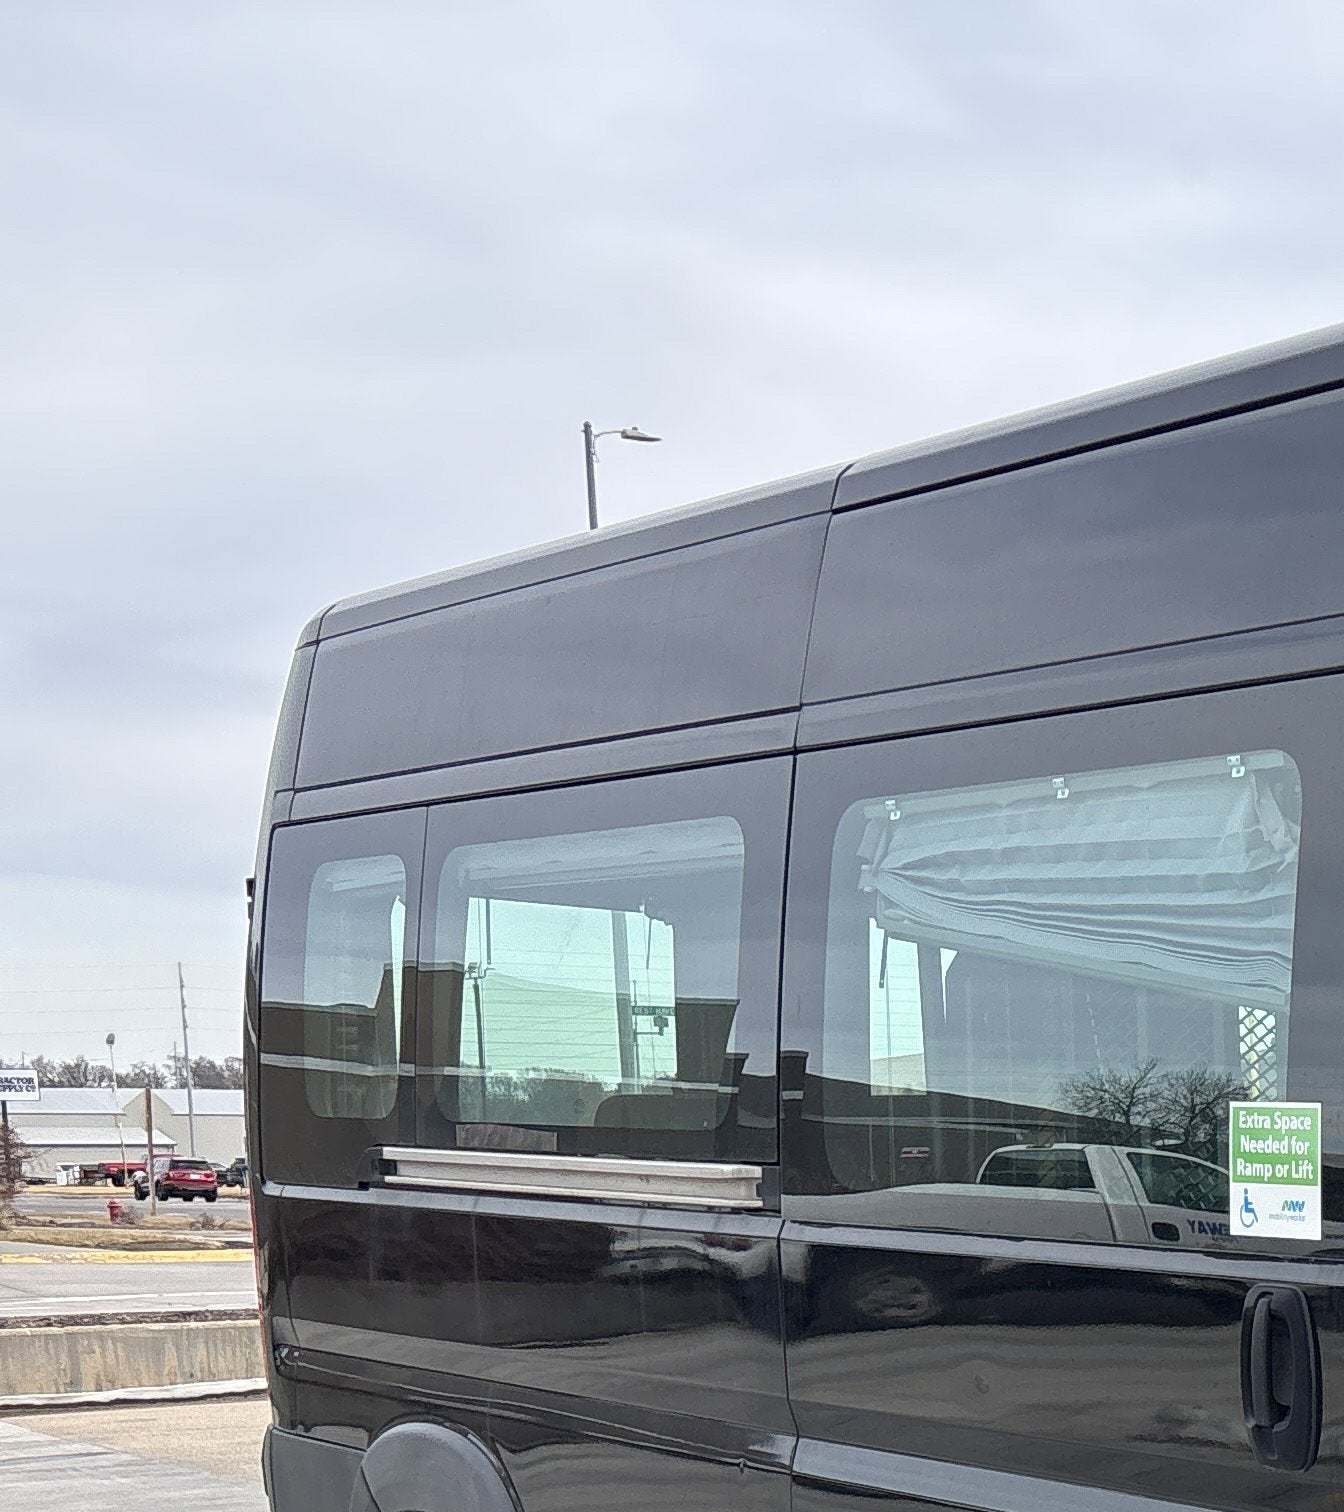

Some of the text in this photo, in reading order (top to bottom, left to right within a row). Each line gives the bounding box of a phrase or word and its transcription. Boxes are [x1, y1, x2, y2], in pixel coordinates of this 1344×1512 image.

[0, 1077, 35, 1085] RACTOR
[1238, 1111, 1312, 1134] Extra Space
[1240, 1135, 1310, 1156] Needed for
[1236, 1158, 1314, 1181] Ramp or Lift
